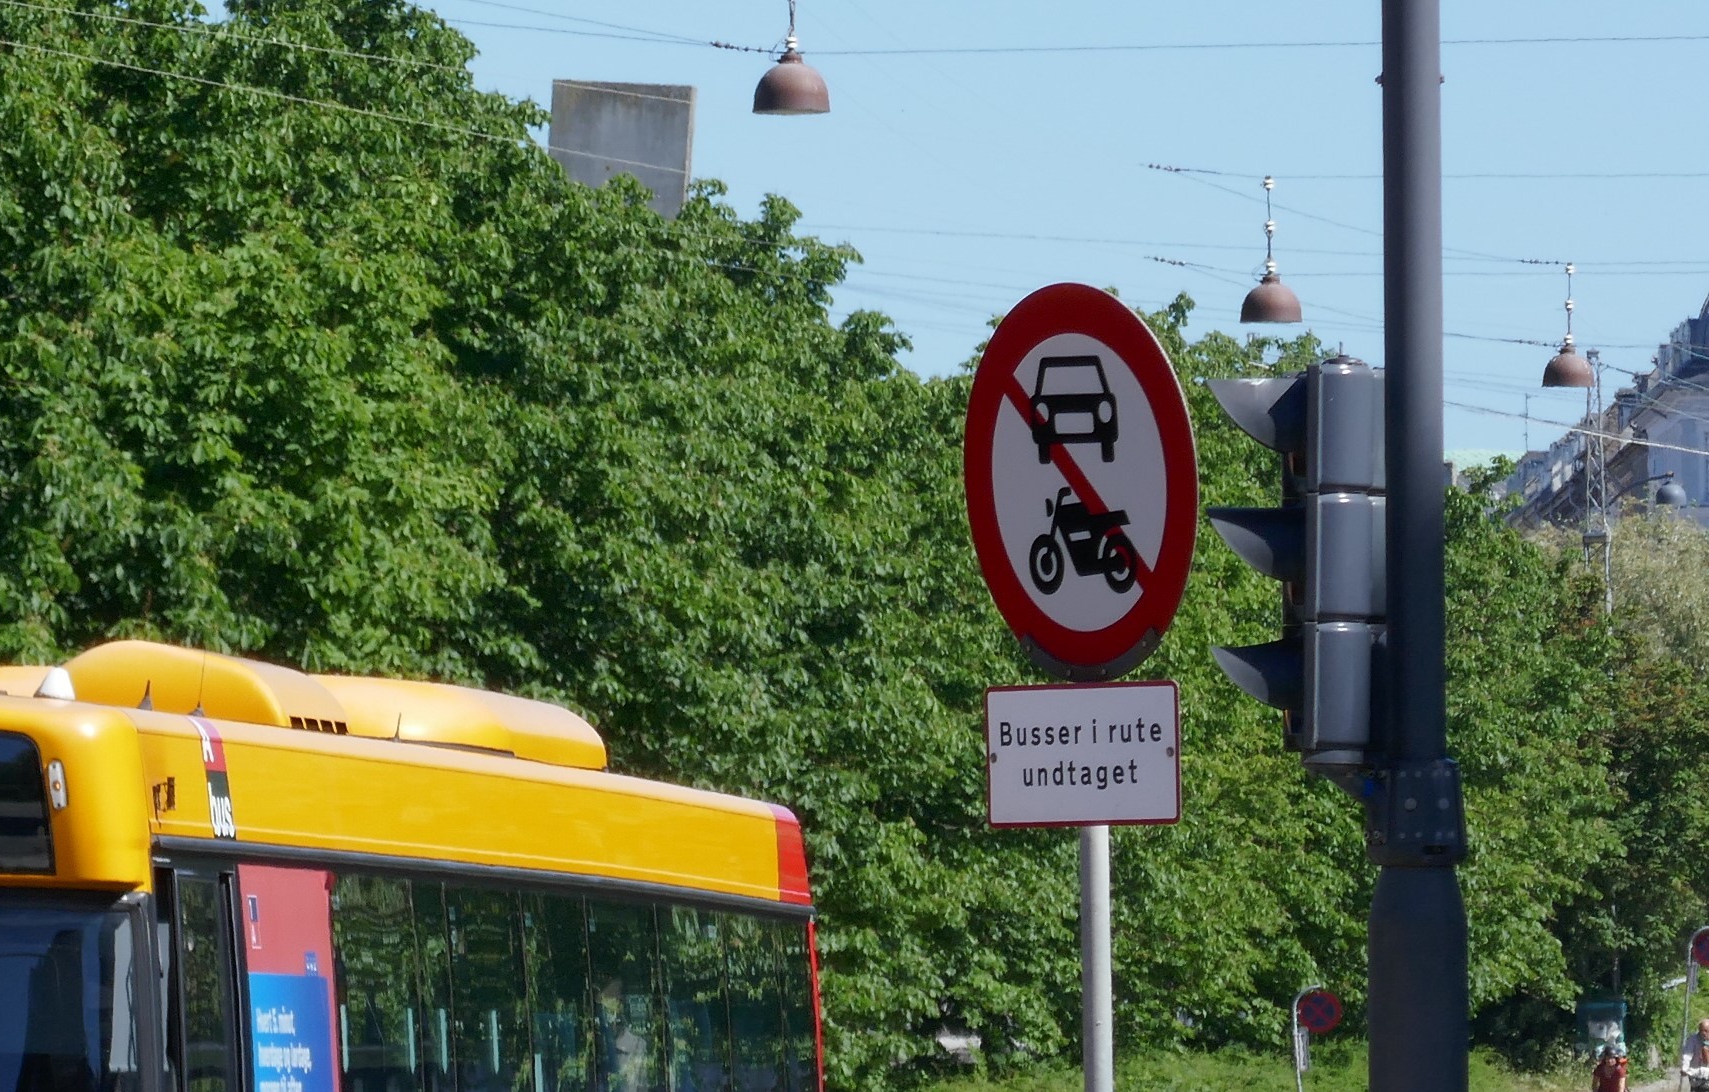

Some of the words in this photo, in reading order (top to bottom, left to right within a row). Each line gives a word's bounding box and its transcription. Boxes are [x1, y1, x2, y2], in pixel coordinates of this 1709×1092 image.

[999, 721, 1082, 746] Busser
[1092, 718, 1097, 744] i
[1109, 717, 1162, 743] rute
[1023, 759, 1138, 790] undtaget
[207, 782, 236, 838] bus
